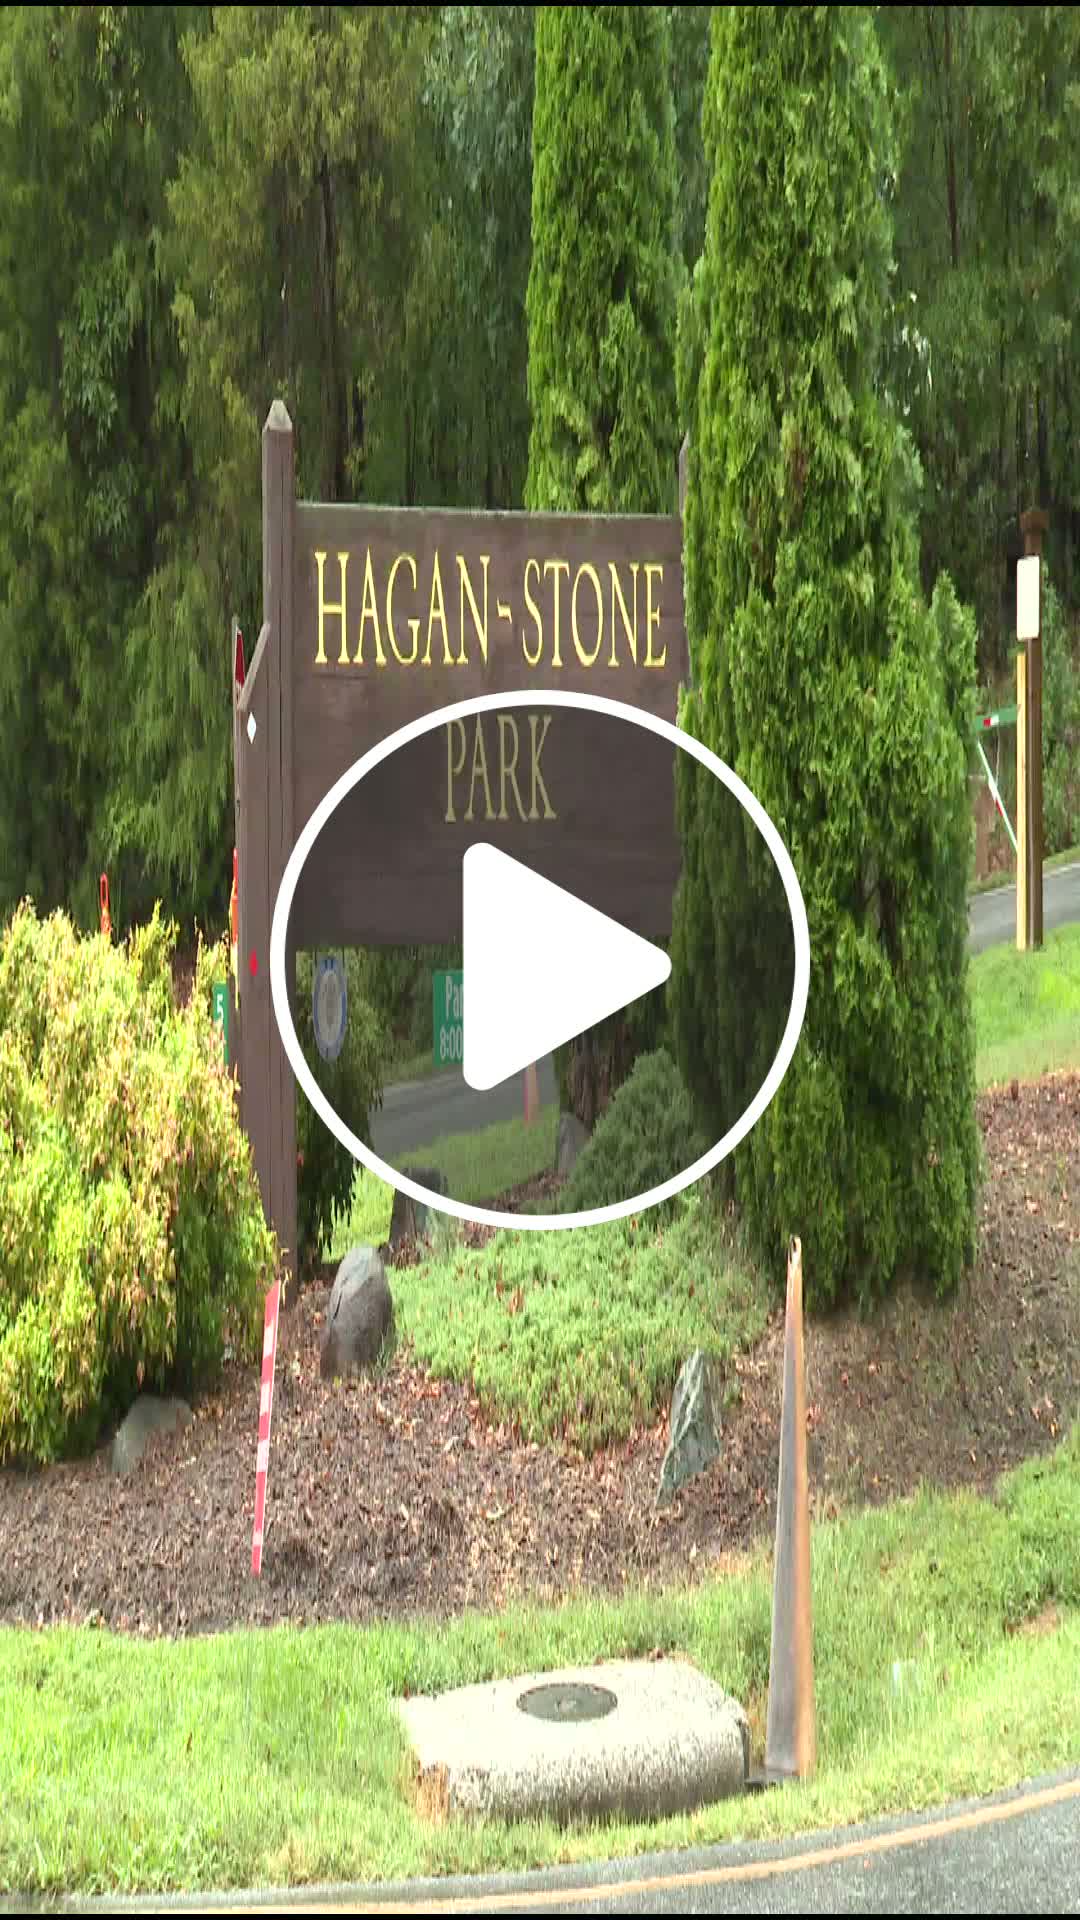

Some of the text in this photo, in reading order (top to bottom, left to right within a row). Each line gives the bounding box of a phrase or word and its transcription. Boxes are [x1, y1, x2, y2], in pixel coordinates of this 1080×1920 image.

[314, 546, 668, 668] HAGAN-STONE
[444, 712, 558, 823] PARK
[440, 1024, 463, 1061] 8:00
